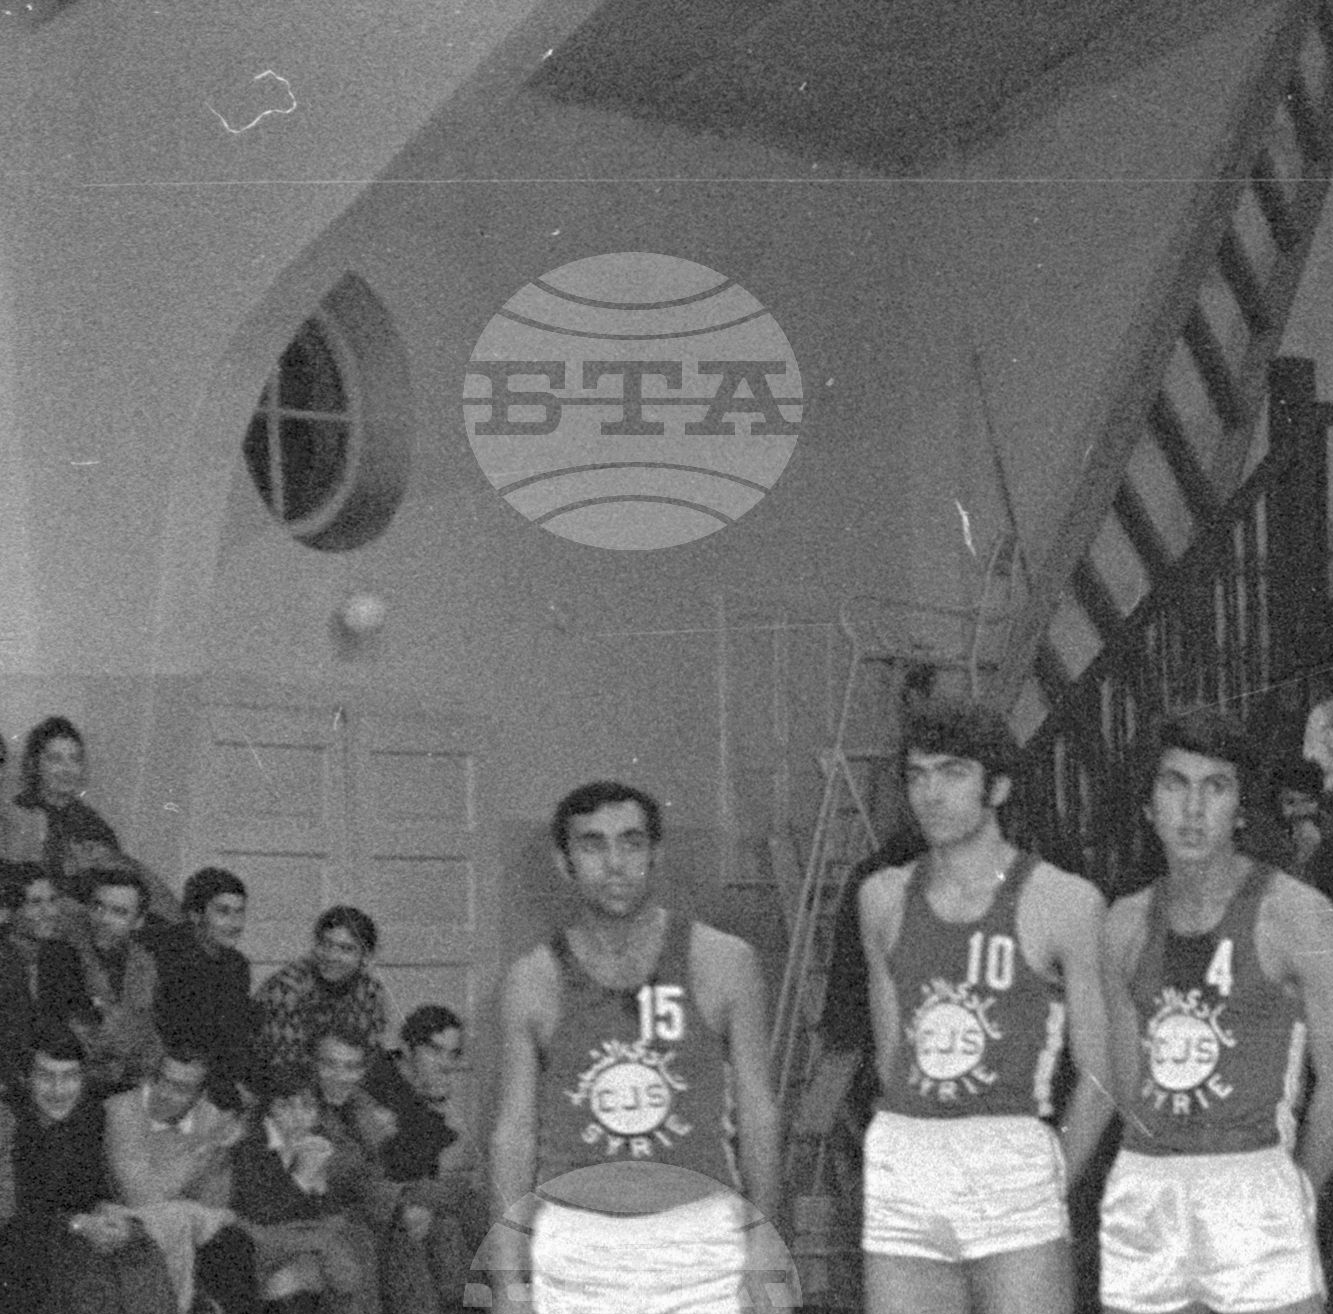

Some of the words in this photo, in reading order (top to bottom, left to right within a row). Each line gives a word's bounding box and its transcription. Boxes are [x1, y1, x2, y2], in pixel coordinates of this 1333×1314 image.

[967, 931, 1014, 990] 10
[1206, 938, 1234, 996] 4
[638, 985, 684, 1040] 15
[599, 1085, 667, 1112] CJS
